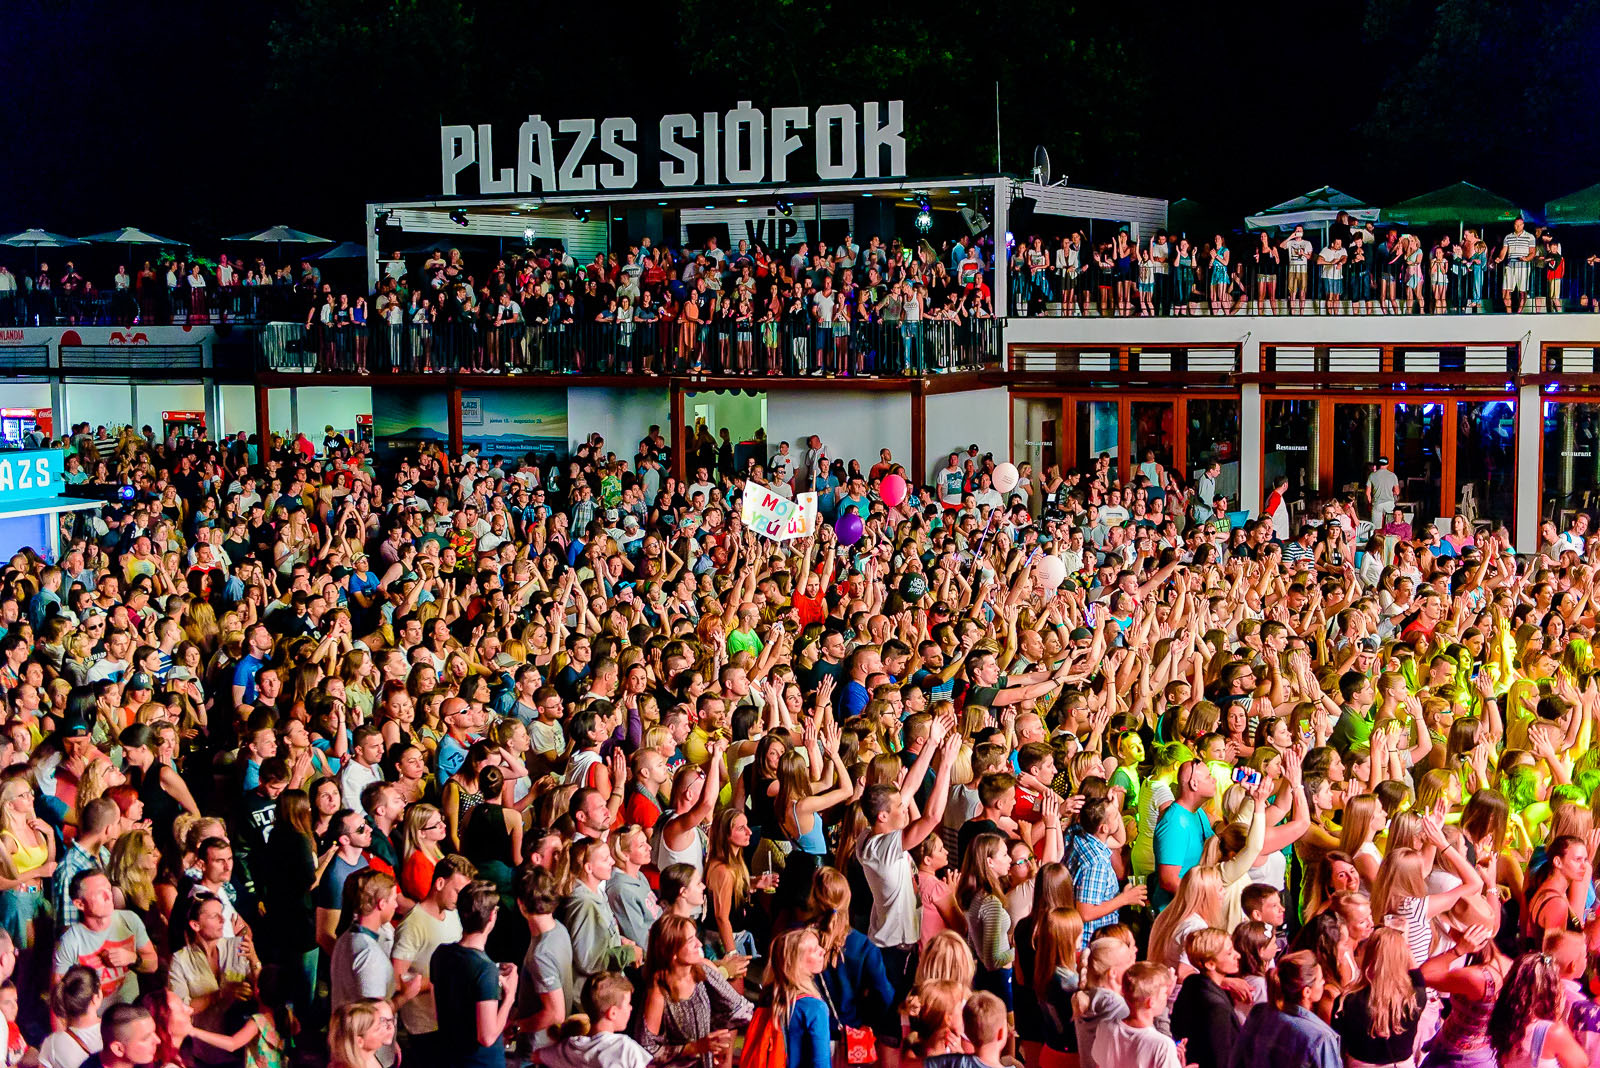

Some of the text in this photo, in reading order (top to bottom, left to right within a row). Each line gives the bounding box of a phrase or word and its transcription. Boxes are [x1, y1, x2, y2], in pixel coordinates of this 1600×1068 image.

[441, 100, 906, 195] PLÁZS SIÓFOK
[1275, 443, 1308, 451] Restaurant
